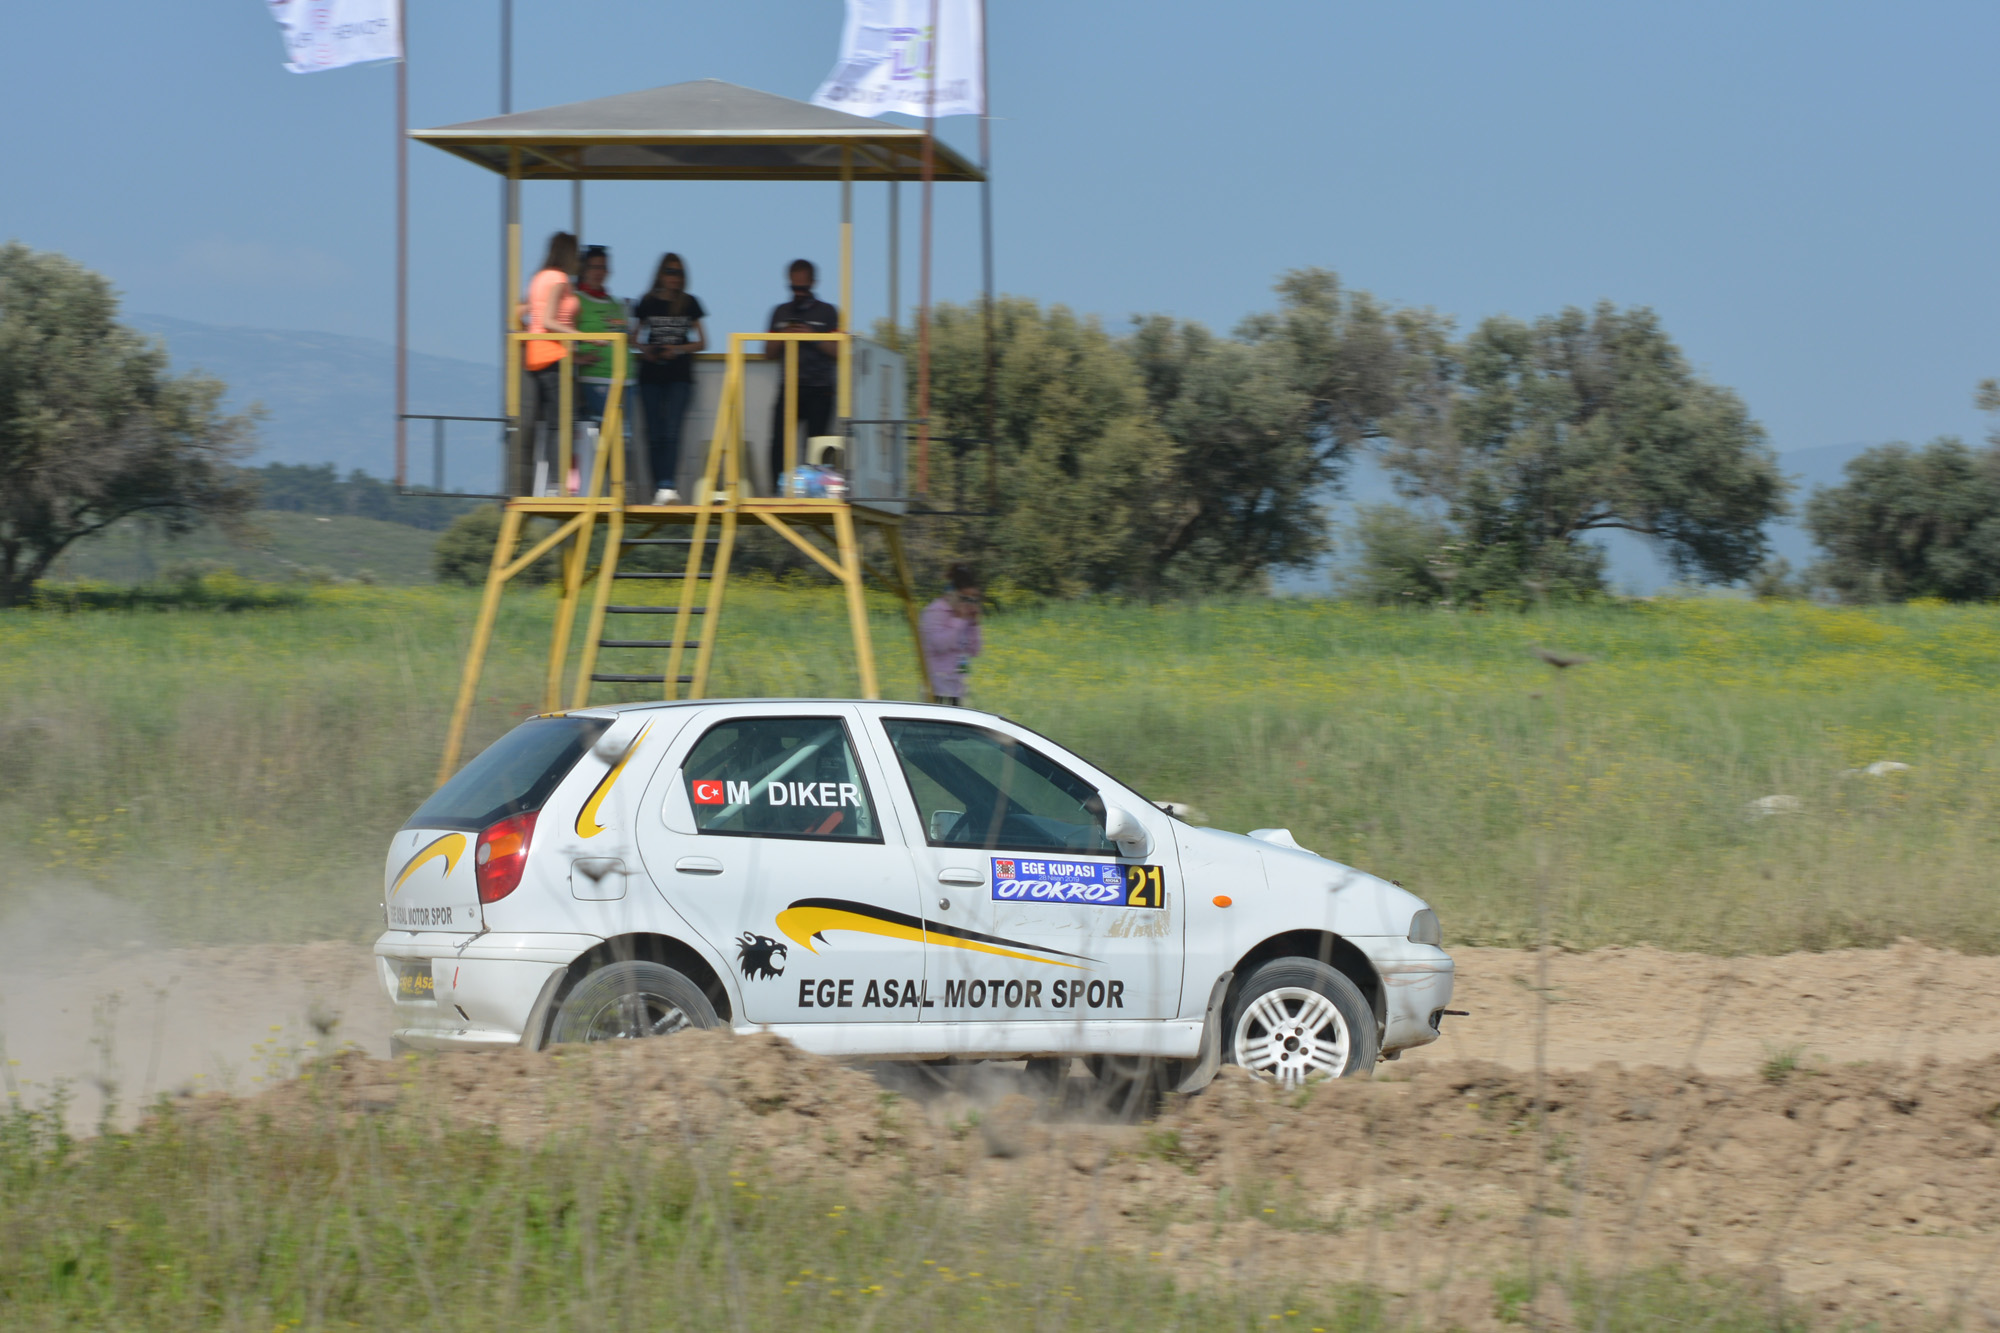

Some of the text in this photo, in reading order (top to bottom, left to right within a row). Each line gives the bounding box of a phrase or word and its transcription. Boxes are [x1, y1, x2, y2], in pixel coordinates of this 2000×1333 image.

[726, 780, 861, 807] M DIKER
[1021, 862, 1095, 878] EGE KUPASI
[996, 879, 1122, 902] OTOKROS
[1128, 865, 1161, 907] 21
[408, 907, 430, 926] MOTOR
[431, 906, 453, 926] SPOR
[414, 972, 434, 990] Asa
[798, 979, 1124, 1009] EGE ASAL MOTOR SPOR
